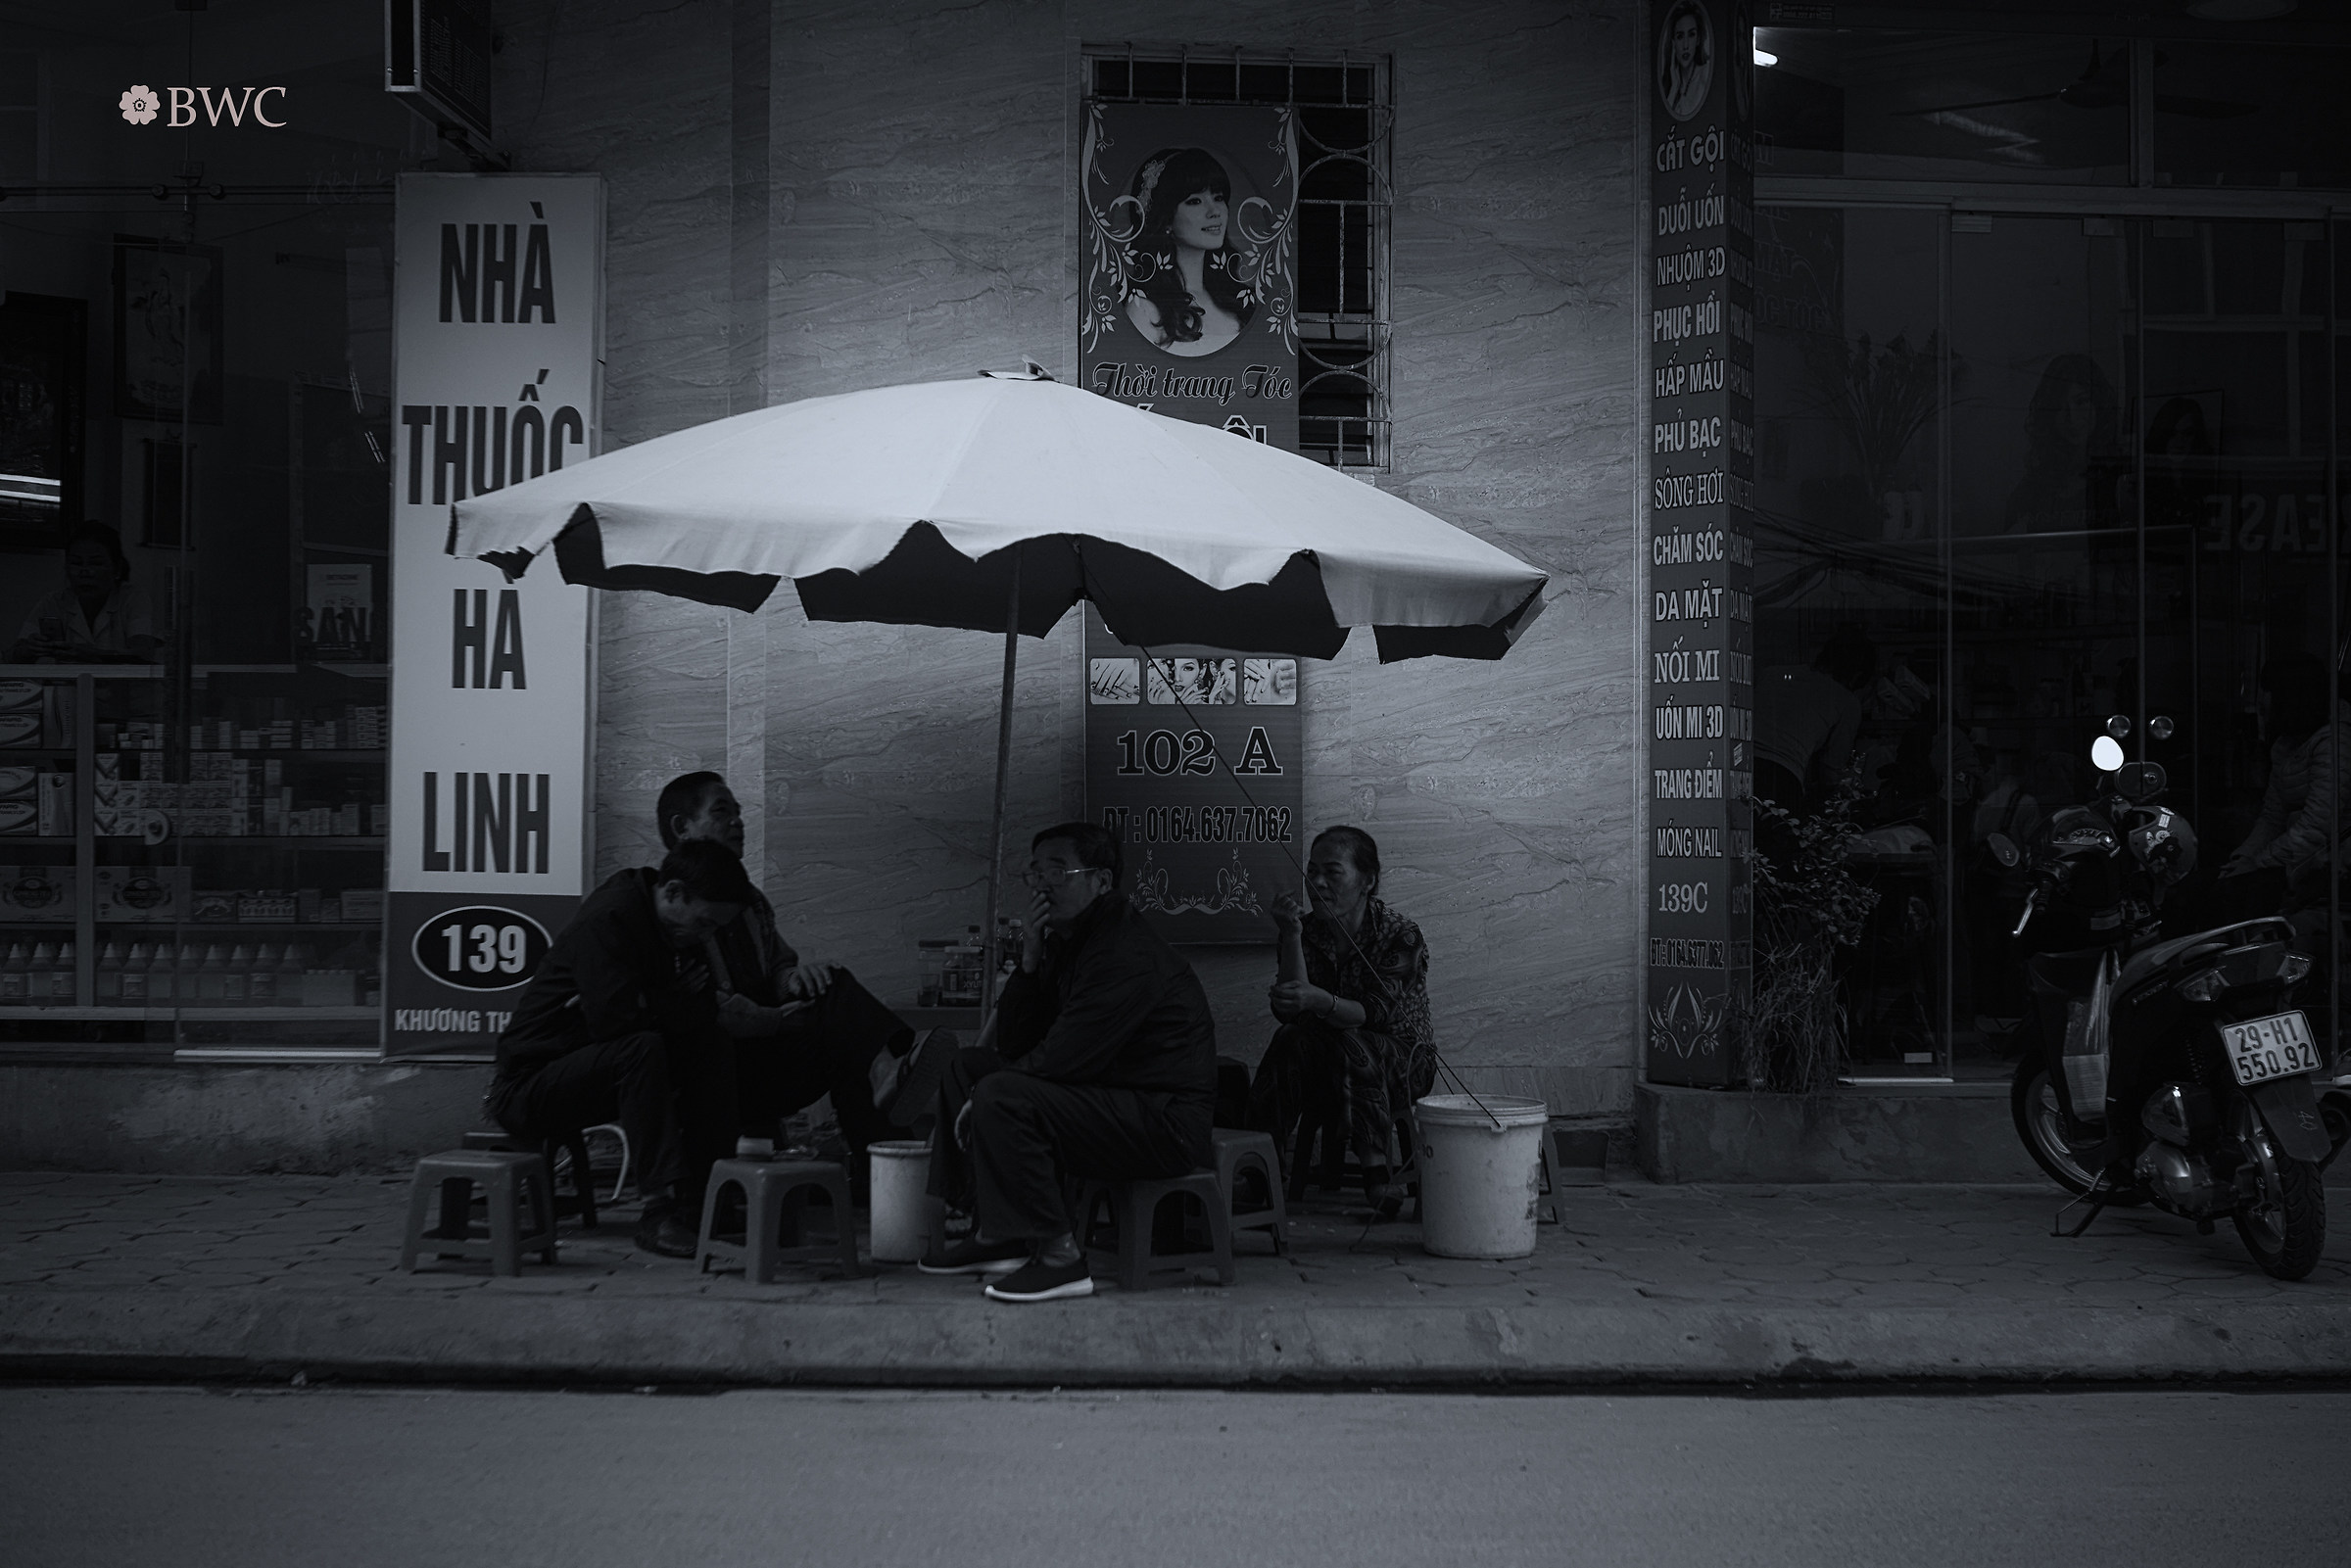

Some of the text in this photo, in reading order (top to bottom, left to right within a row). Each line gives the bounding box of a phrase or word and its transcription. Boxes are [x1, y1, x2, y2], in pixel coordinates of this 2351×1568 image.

[1656, 124, 1686, 172] CẮT
[1690, 124, 1725, 172] GỘI
[1658, 185, 1692, 236] DUỖI
[1695, 183, 1724, 229] UỐN
[439, 202, 555, 324] NHÀ
[1656, 243, 1704, 292] NHUỘM
[1707, 246, 1726, 278] 3D
[1654, 305, 1692, 347] PHỤC
[1696, 290, 1721, 336] HỒI
[1092, 361, 1292, 406] Thời trang Tóc
[1655, 352, 1686, 398] HẤP
[402, 368, 584, 505] THUỐC
[1655, 408, 1721, 458] PHỦ BẠC
[1655, 466, 1695, 509] SÔNG
[1697, 466, 1724, 505] HƠI
[1654, 523, 1724, 566] CHĂM SÓC
[1655, 580, 1723, 629] DA MẶT
[1655, 636, 1720, 683] NỐI MI
[1655, 694, 1724, 739] UỐN MI 3D
[1117, 726, 1283, 776] 102 A
[1655, 769, 1692, 798] TRANG
[1695, 751, 1723, 798] ĐIỂM
[422, 772, 550, 874] LINH
[1145, 806, 1292, 843] 0164.637.7062
[1656, 819, 1692, 857] MÓNG
[1695, 829, 1723, 857] NAIL
[1658, 881, 1708, 913] 139C
[442, 924, 527, 974] 139
[394, 1008, 480, 1032] KHƯƠNG
[2234, 1017, 2298, 1053] 29-H1
[2237, 1042, 2315, 1080] 550.92
